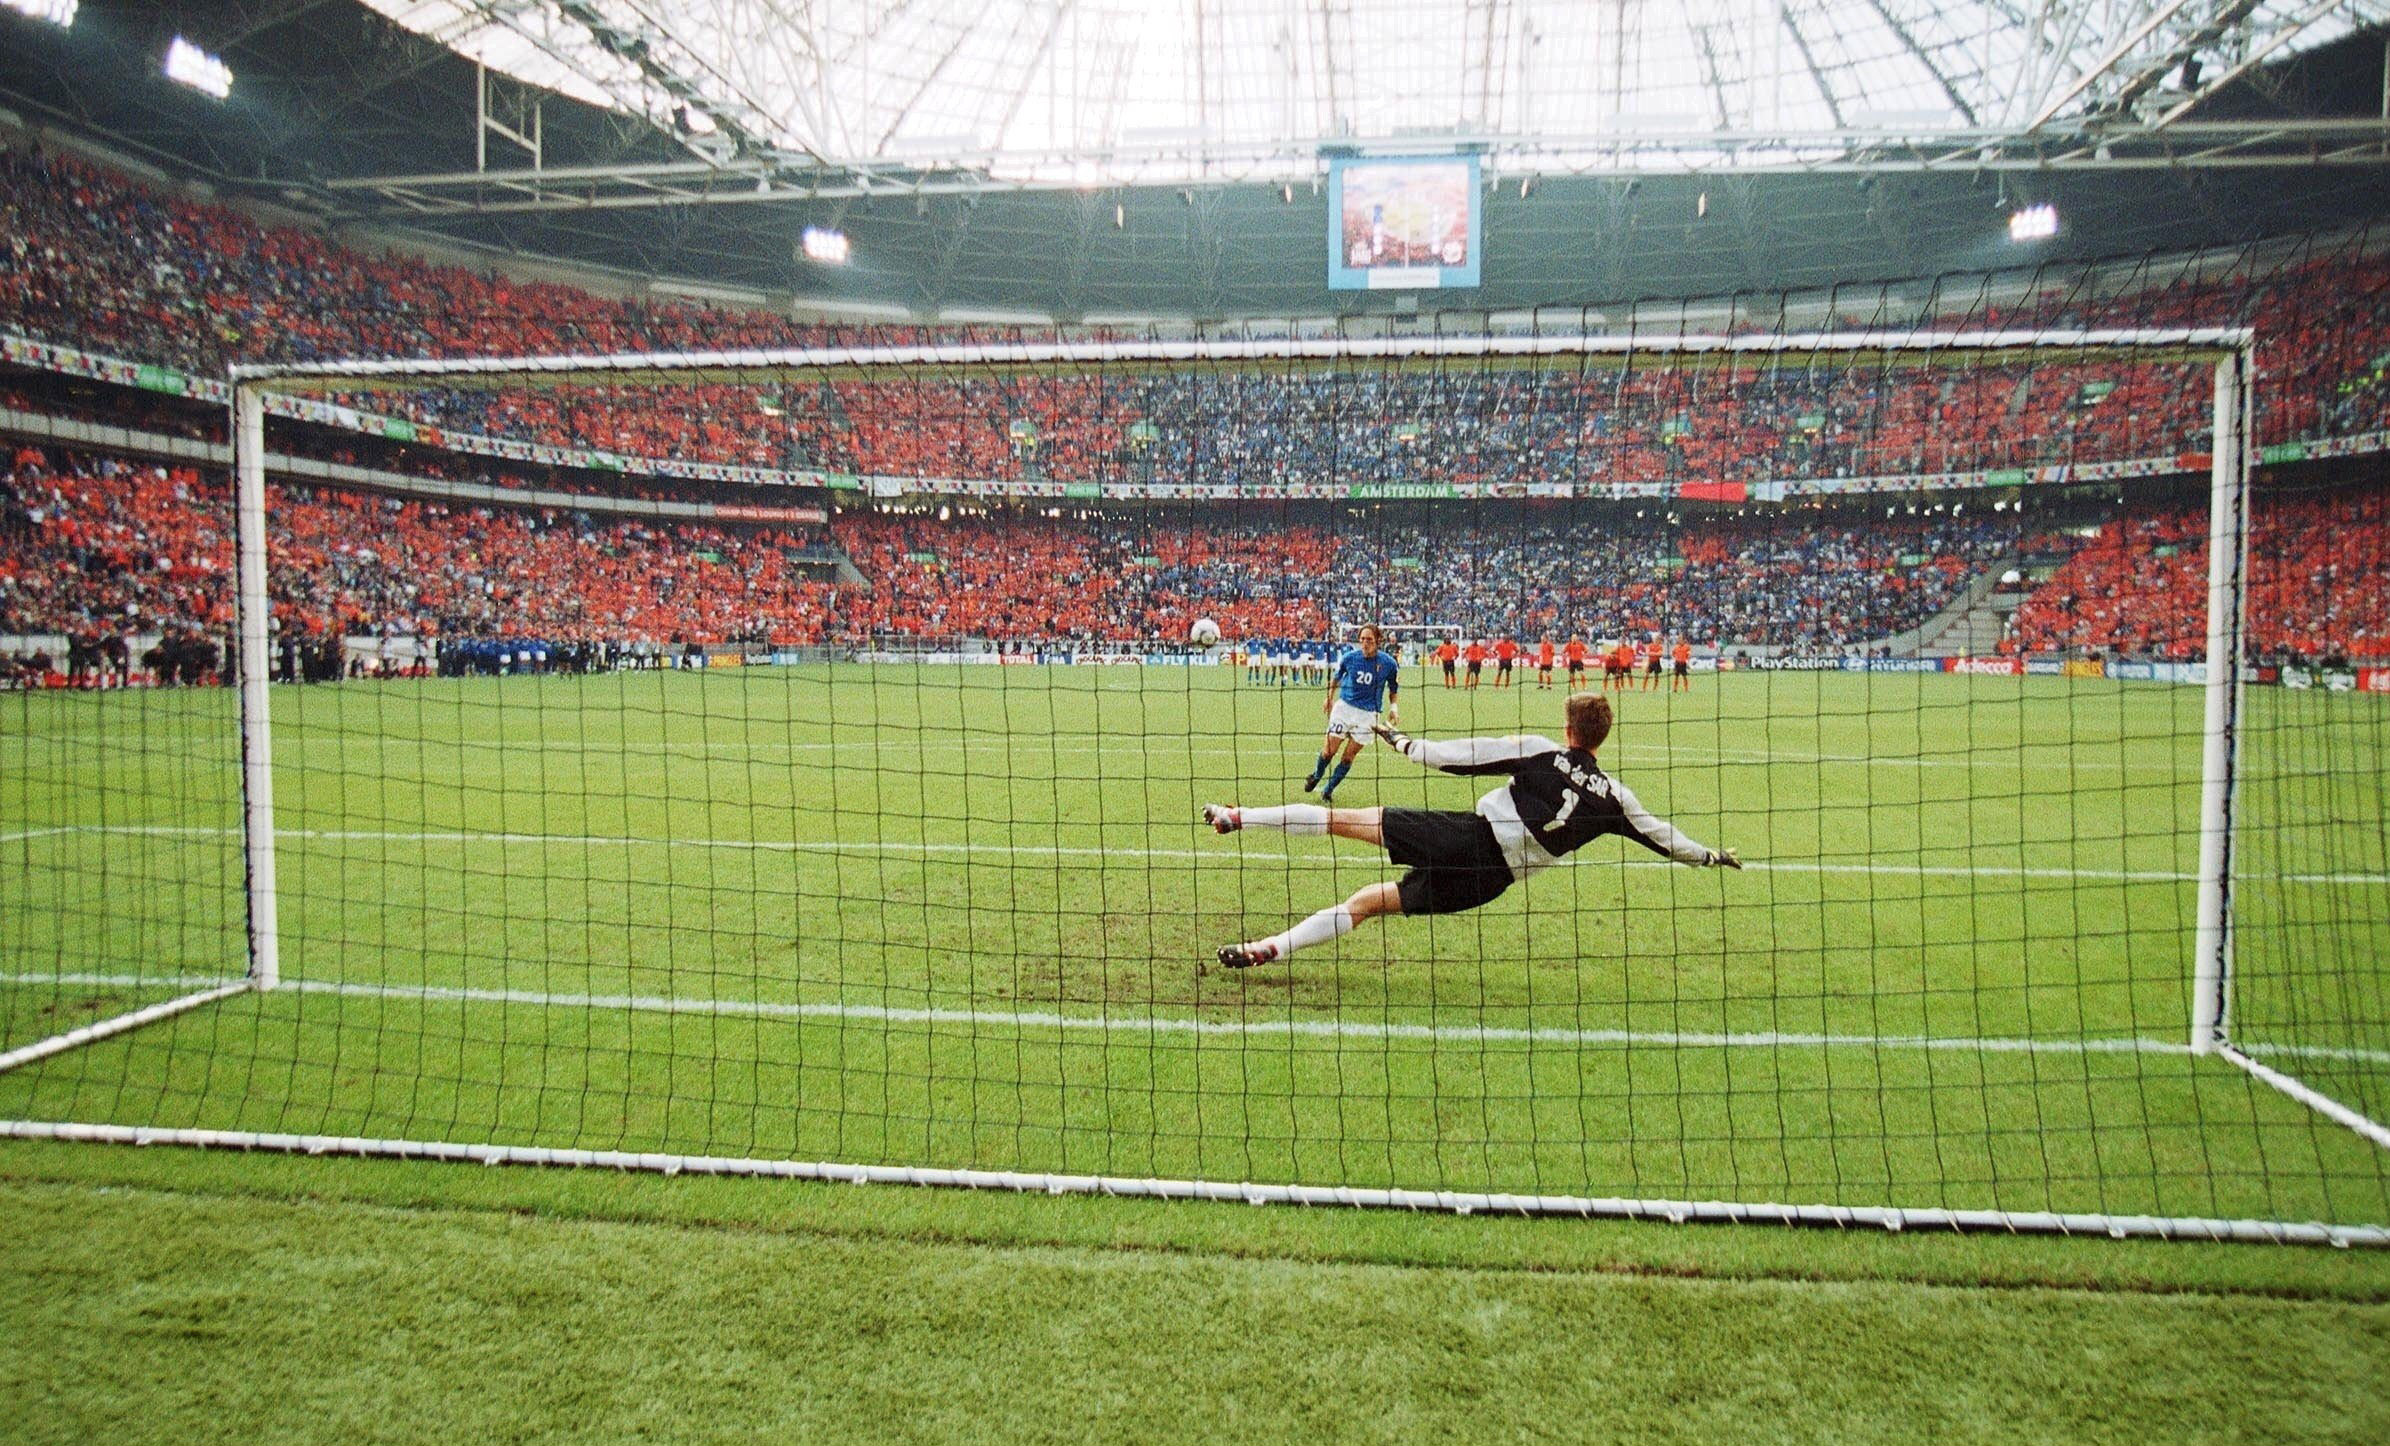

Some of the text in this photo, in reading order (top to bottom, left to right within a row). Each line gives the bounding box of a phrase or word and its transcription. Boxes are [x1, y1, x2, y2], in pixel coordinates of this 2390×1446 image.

[1360, 484, 1449, 498] AMSTERDAM
[1162, 655, 1219, 665] FLY KLM
[1751, 656, 1840, 669] PlayStation
[1954, 658, 2014, 674] Adecco
[1356, 671, 1373, 685] 20
[1329, 723, 1343, 734] 20
[1543, 788, 1580, 832] 1
